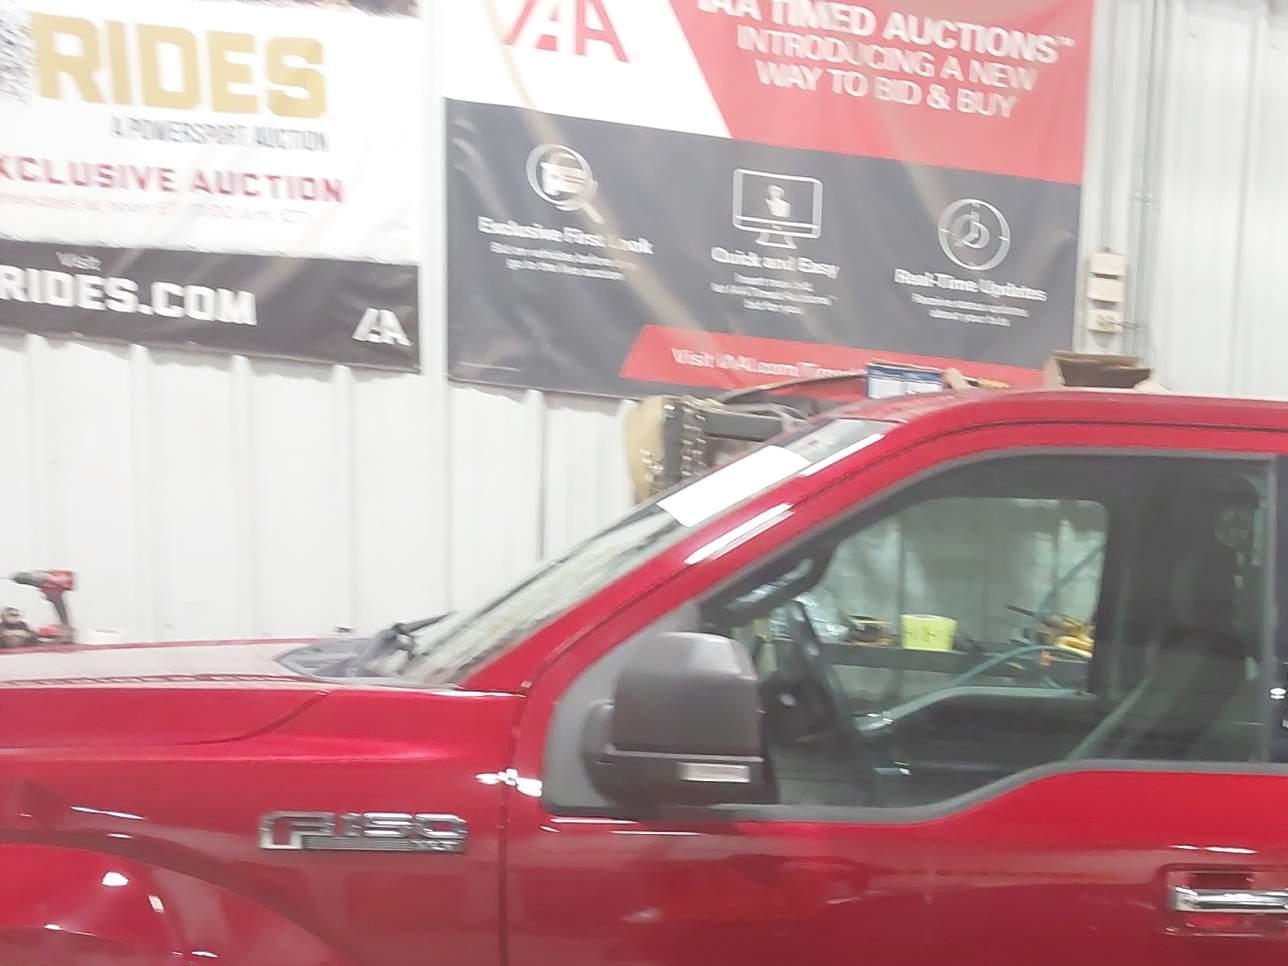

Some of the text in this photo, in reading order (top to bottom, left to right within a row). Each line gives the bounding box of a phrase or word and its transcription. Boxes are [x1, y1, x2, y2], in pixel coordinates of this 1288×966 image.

[770, 0, 877, 36] TIMED
[30, 11, 329, 119] RIDES
[736, 25, 1039, 91] INTRODUCING A NEW
[755, 59, 1019, 118] WAY TO BID & BUY
[192, 168, 344, 203] AUCTION
[711, 246, 762, 269] Quick
[797, 257, 840, 280] Easy
